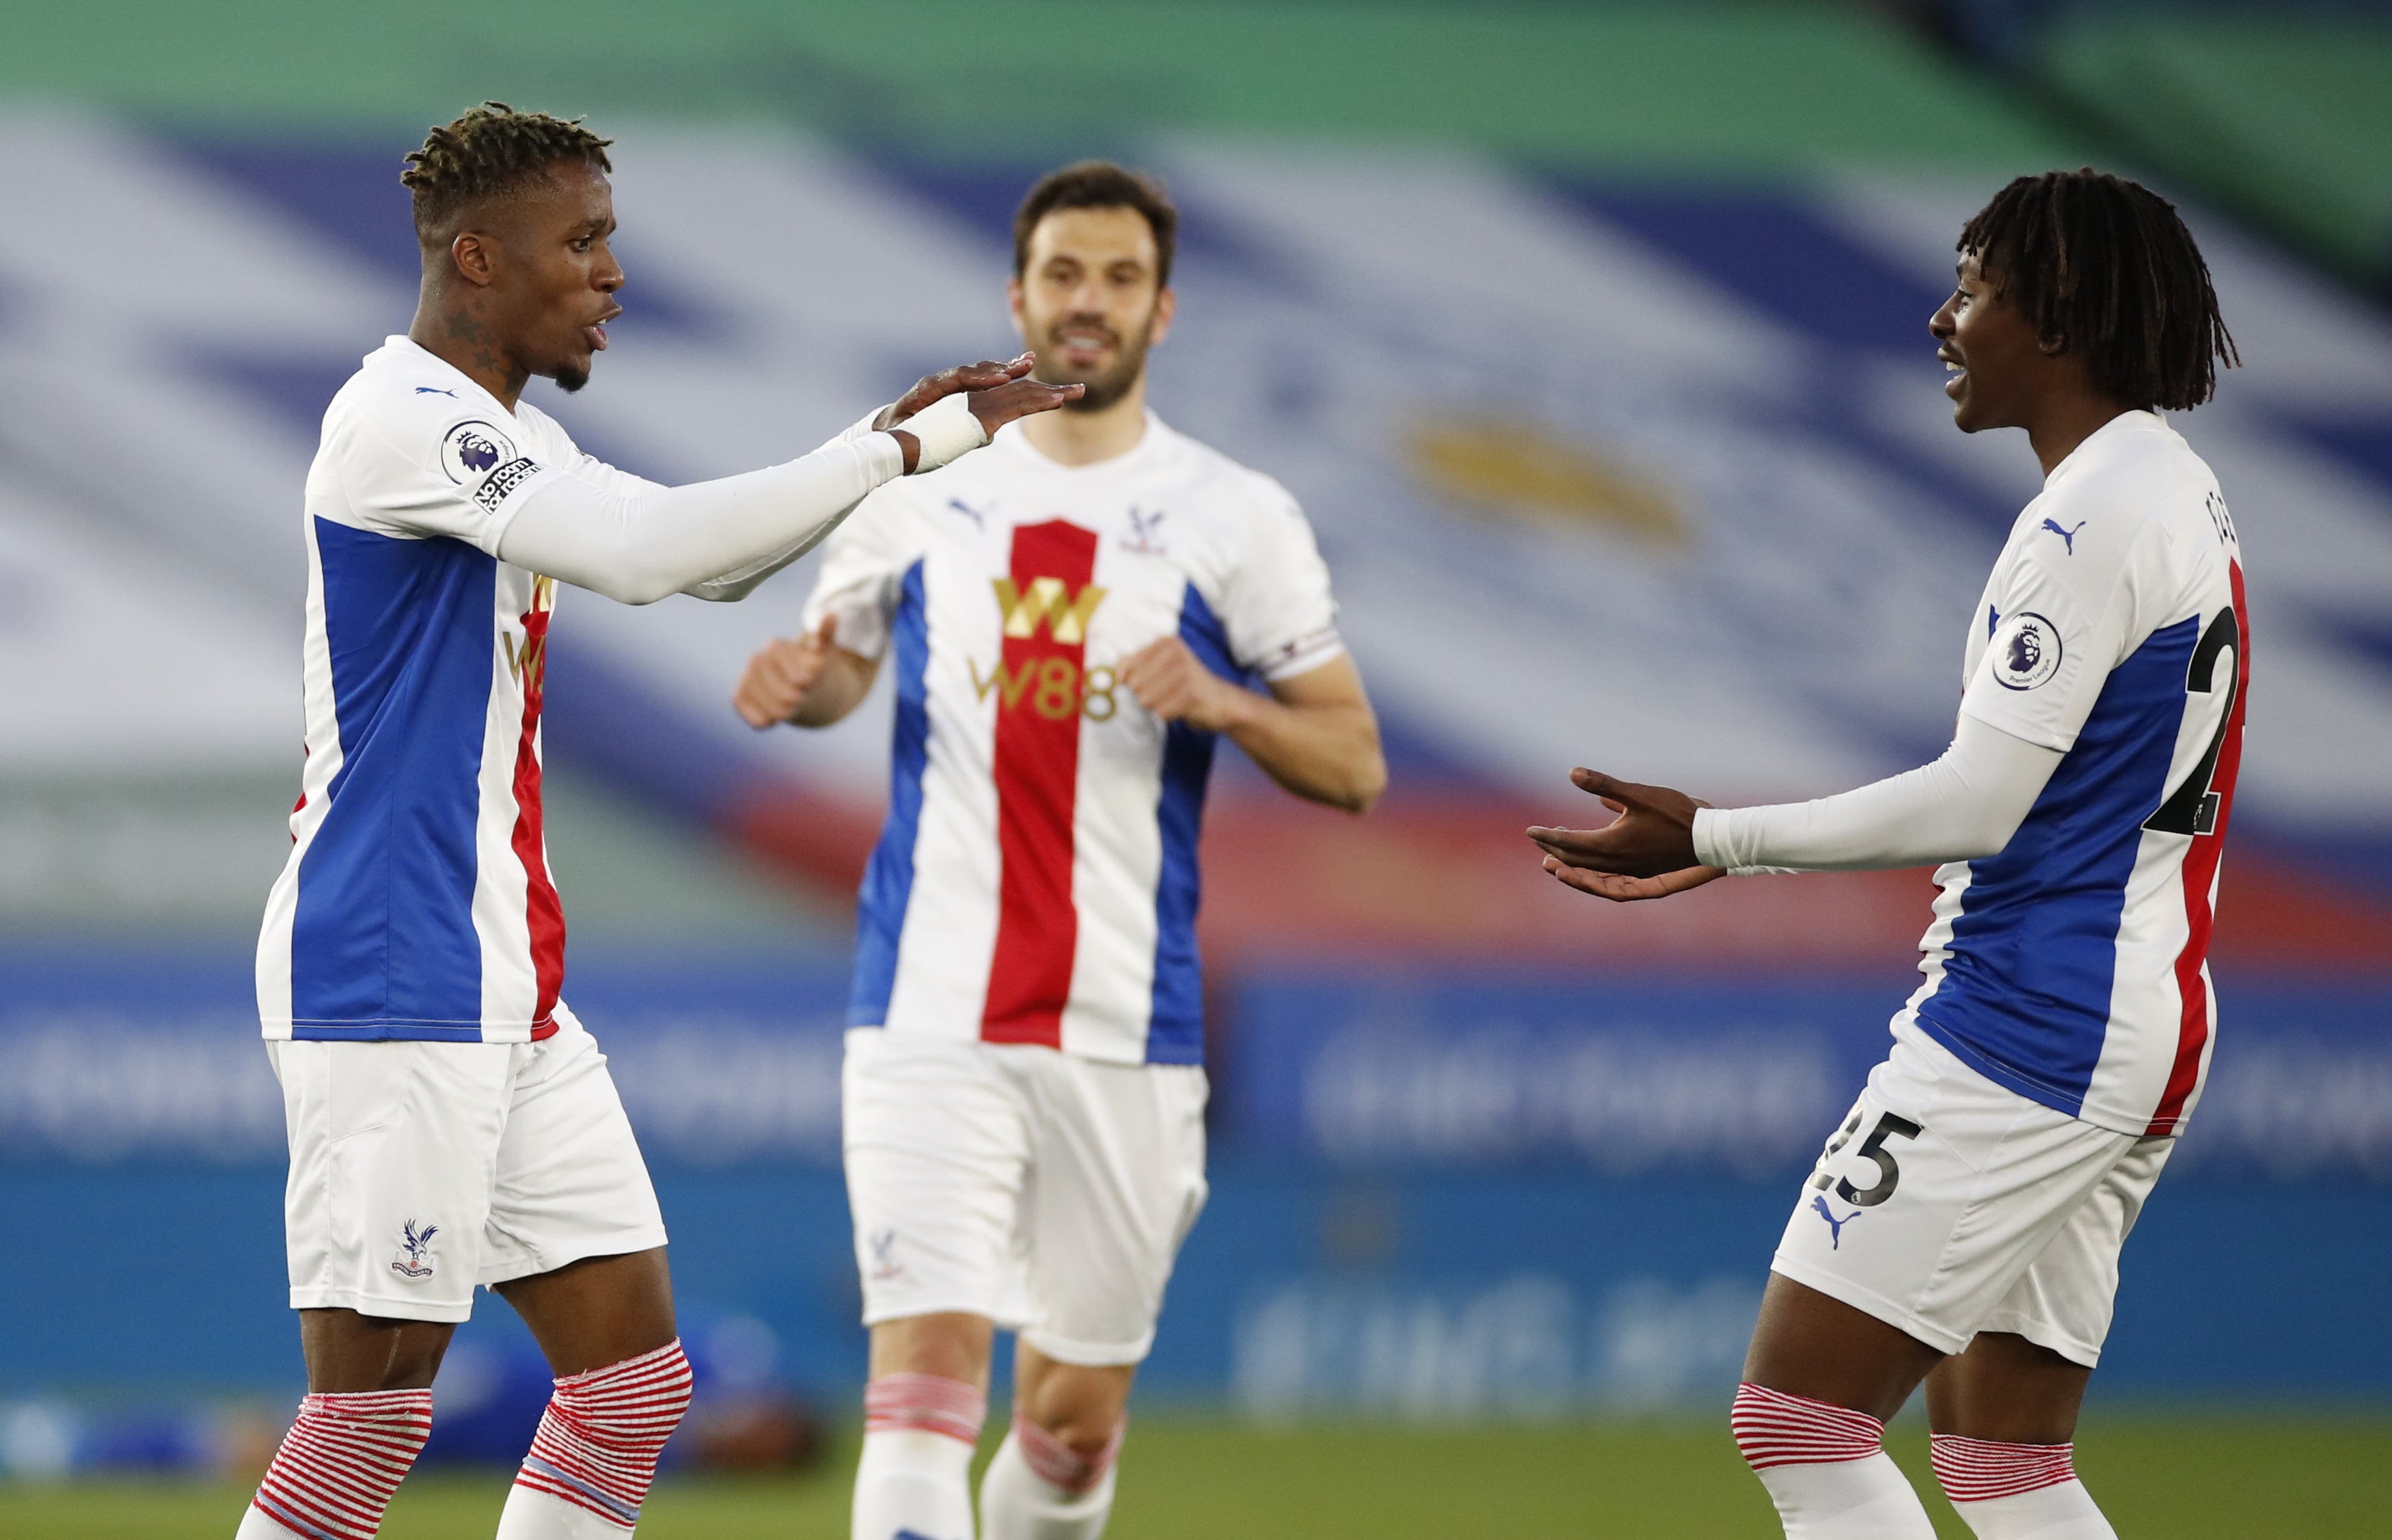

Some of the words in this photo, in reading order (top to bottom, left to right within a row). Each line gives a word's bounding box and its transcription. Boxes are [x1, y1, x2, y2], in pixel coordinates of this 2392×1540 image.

[474, 484, 495, 506] No
[491, 460, 529, 486] room
[483, 490, 503, 514] for
[500, 464, 541, 494] racism
[966, 654, 1117, 721] W88
[2009, 675, 2033, 684] Premier
[2033, 659, 2051, 680] League
